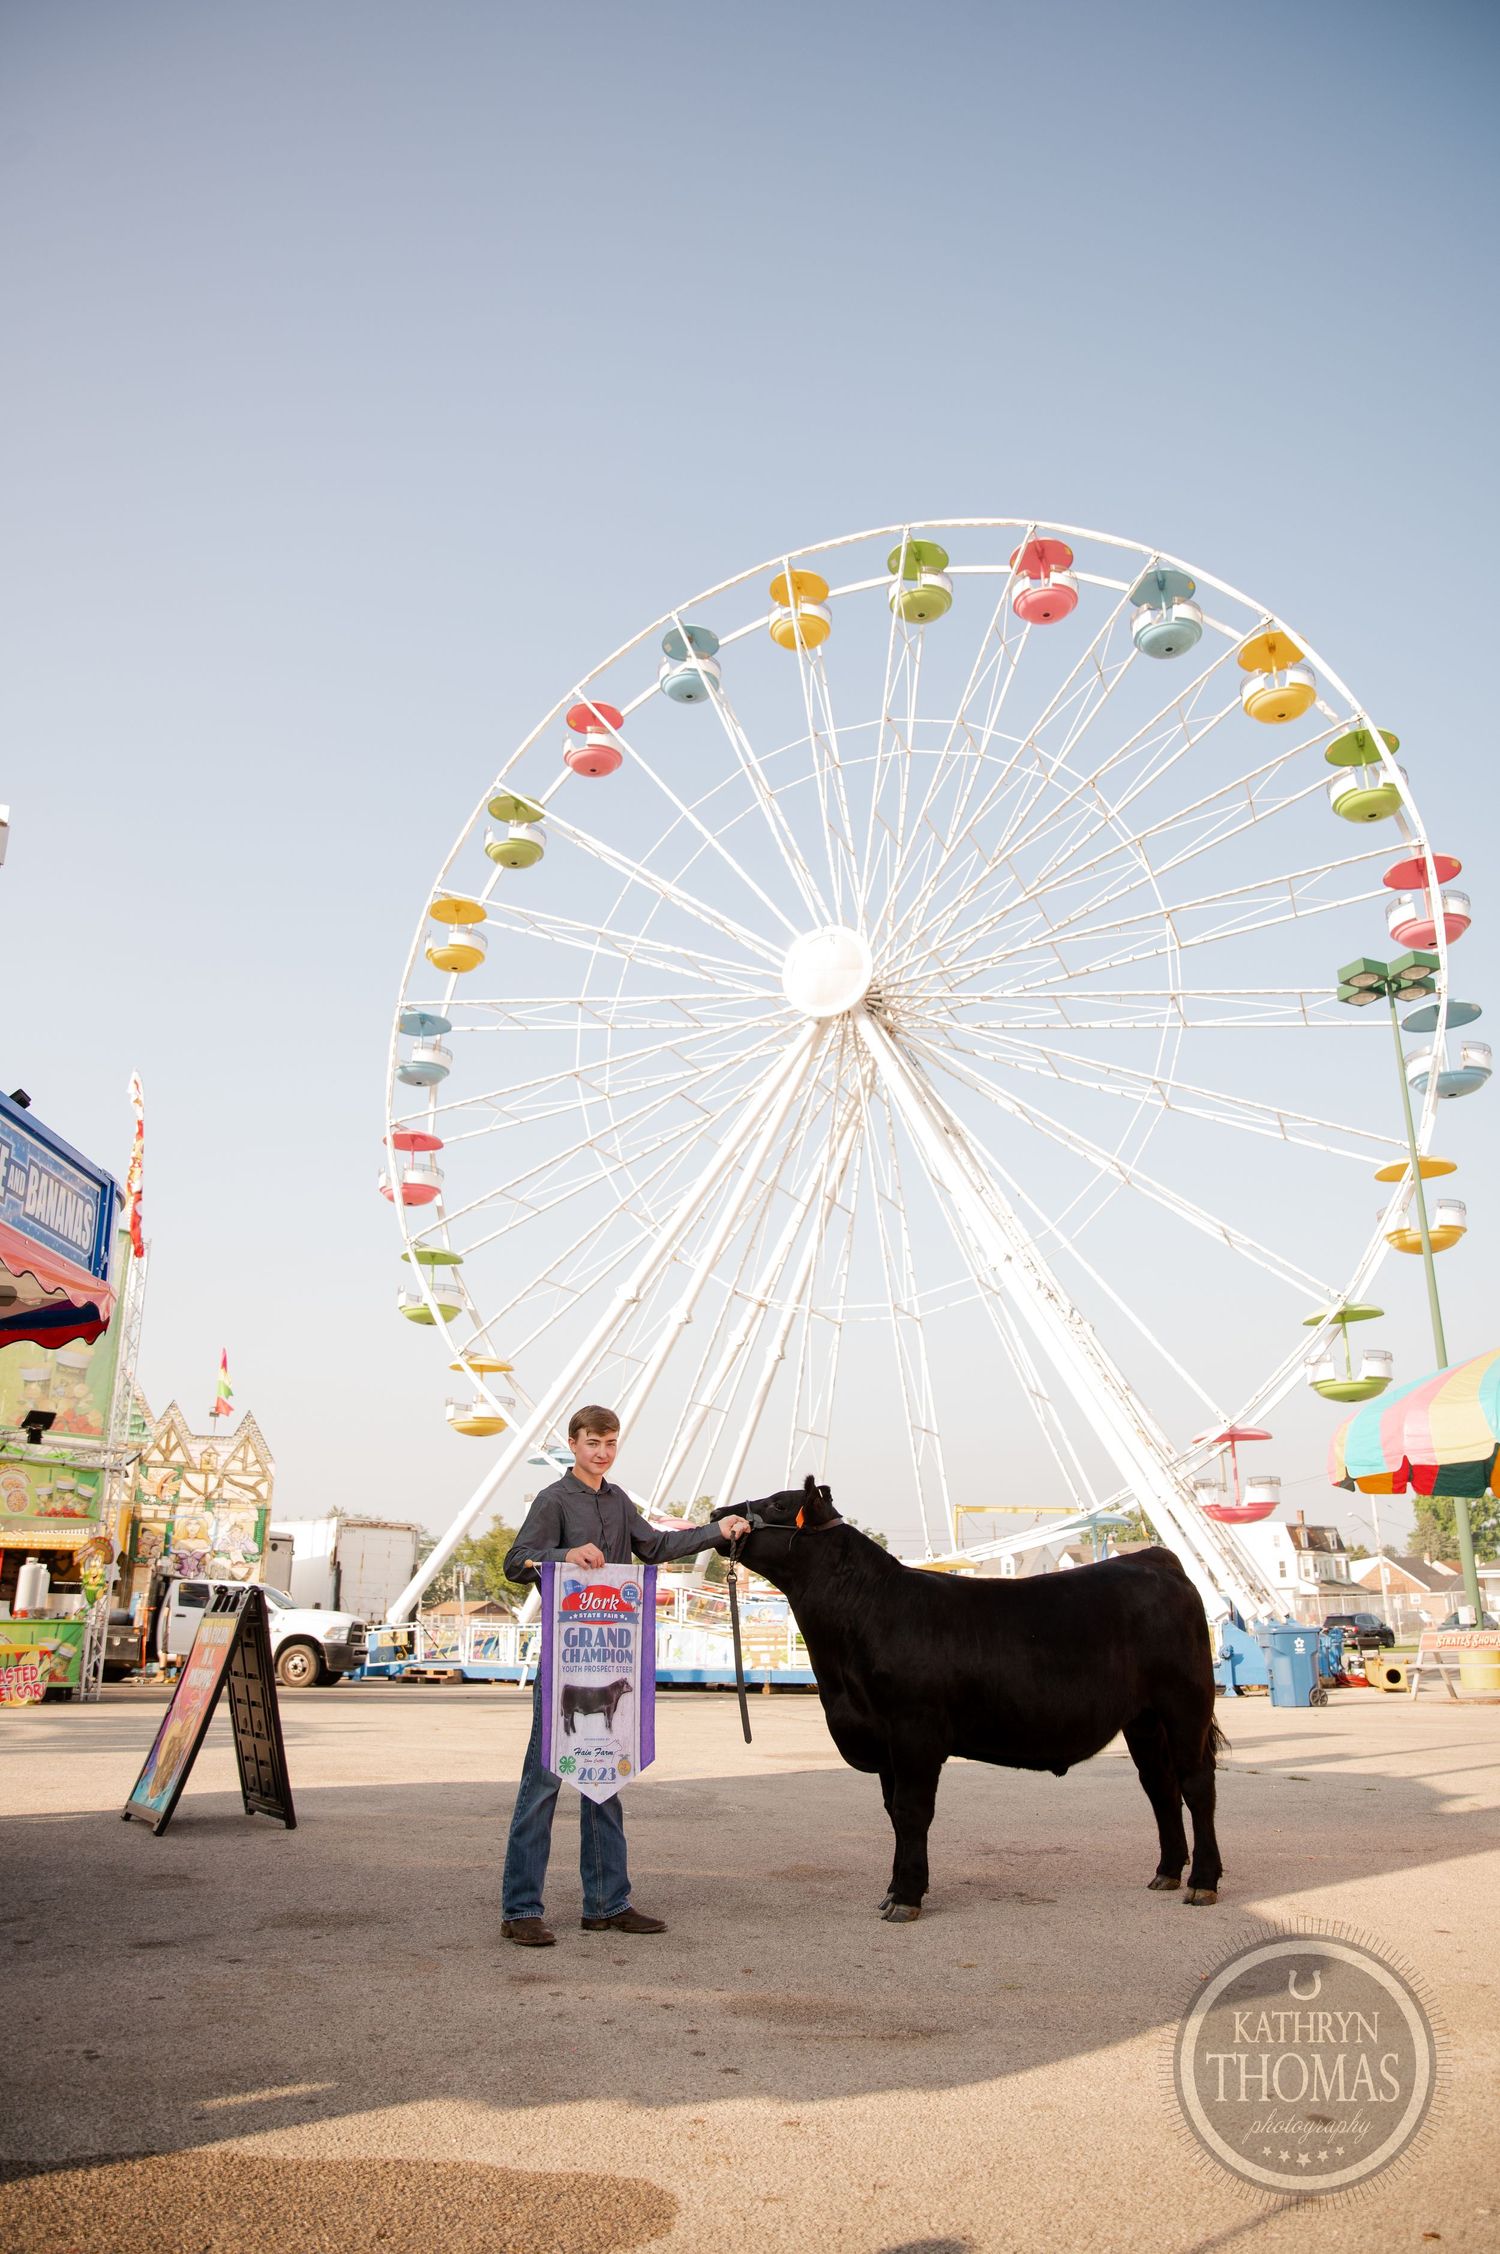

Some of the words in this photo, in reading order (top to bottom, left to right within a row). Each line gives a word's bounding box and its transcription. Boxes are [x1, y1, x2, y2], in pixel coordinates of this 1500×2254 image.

[8, 1164, 26, 1197] AND
[25, 1164, 93, 1251] BANANAS
[579, 1591, 620, 1611] York
[564, 1627, 632, 1649] GRAND
[562, 1648, 633, 1664] CHAMPION
[562, 1665, 583, 1673] YOUTH
[584, 1665, 615, 1673] PROSPECT
[616, 1666, 633, 1674] STEER
[573, 1747, 592, 1756] Hain
[594, 1747, 614, 1758] Farm
[577, 1766, 617, 1781] 2023
